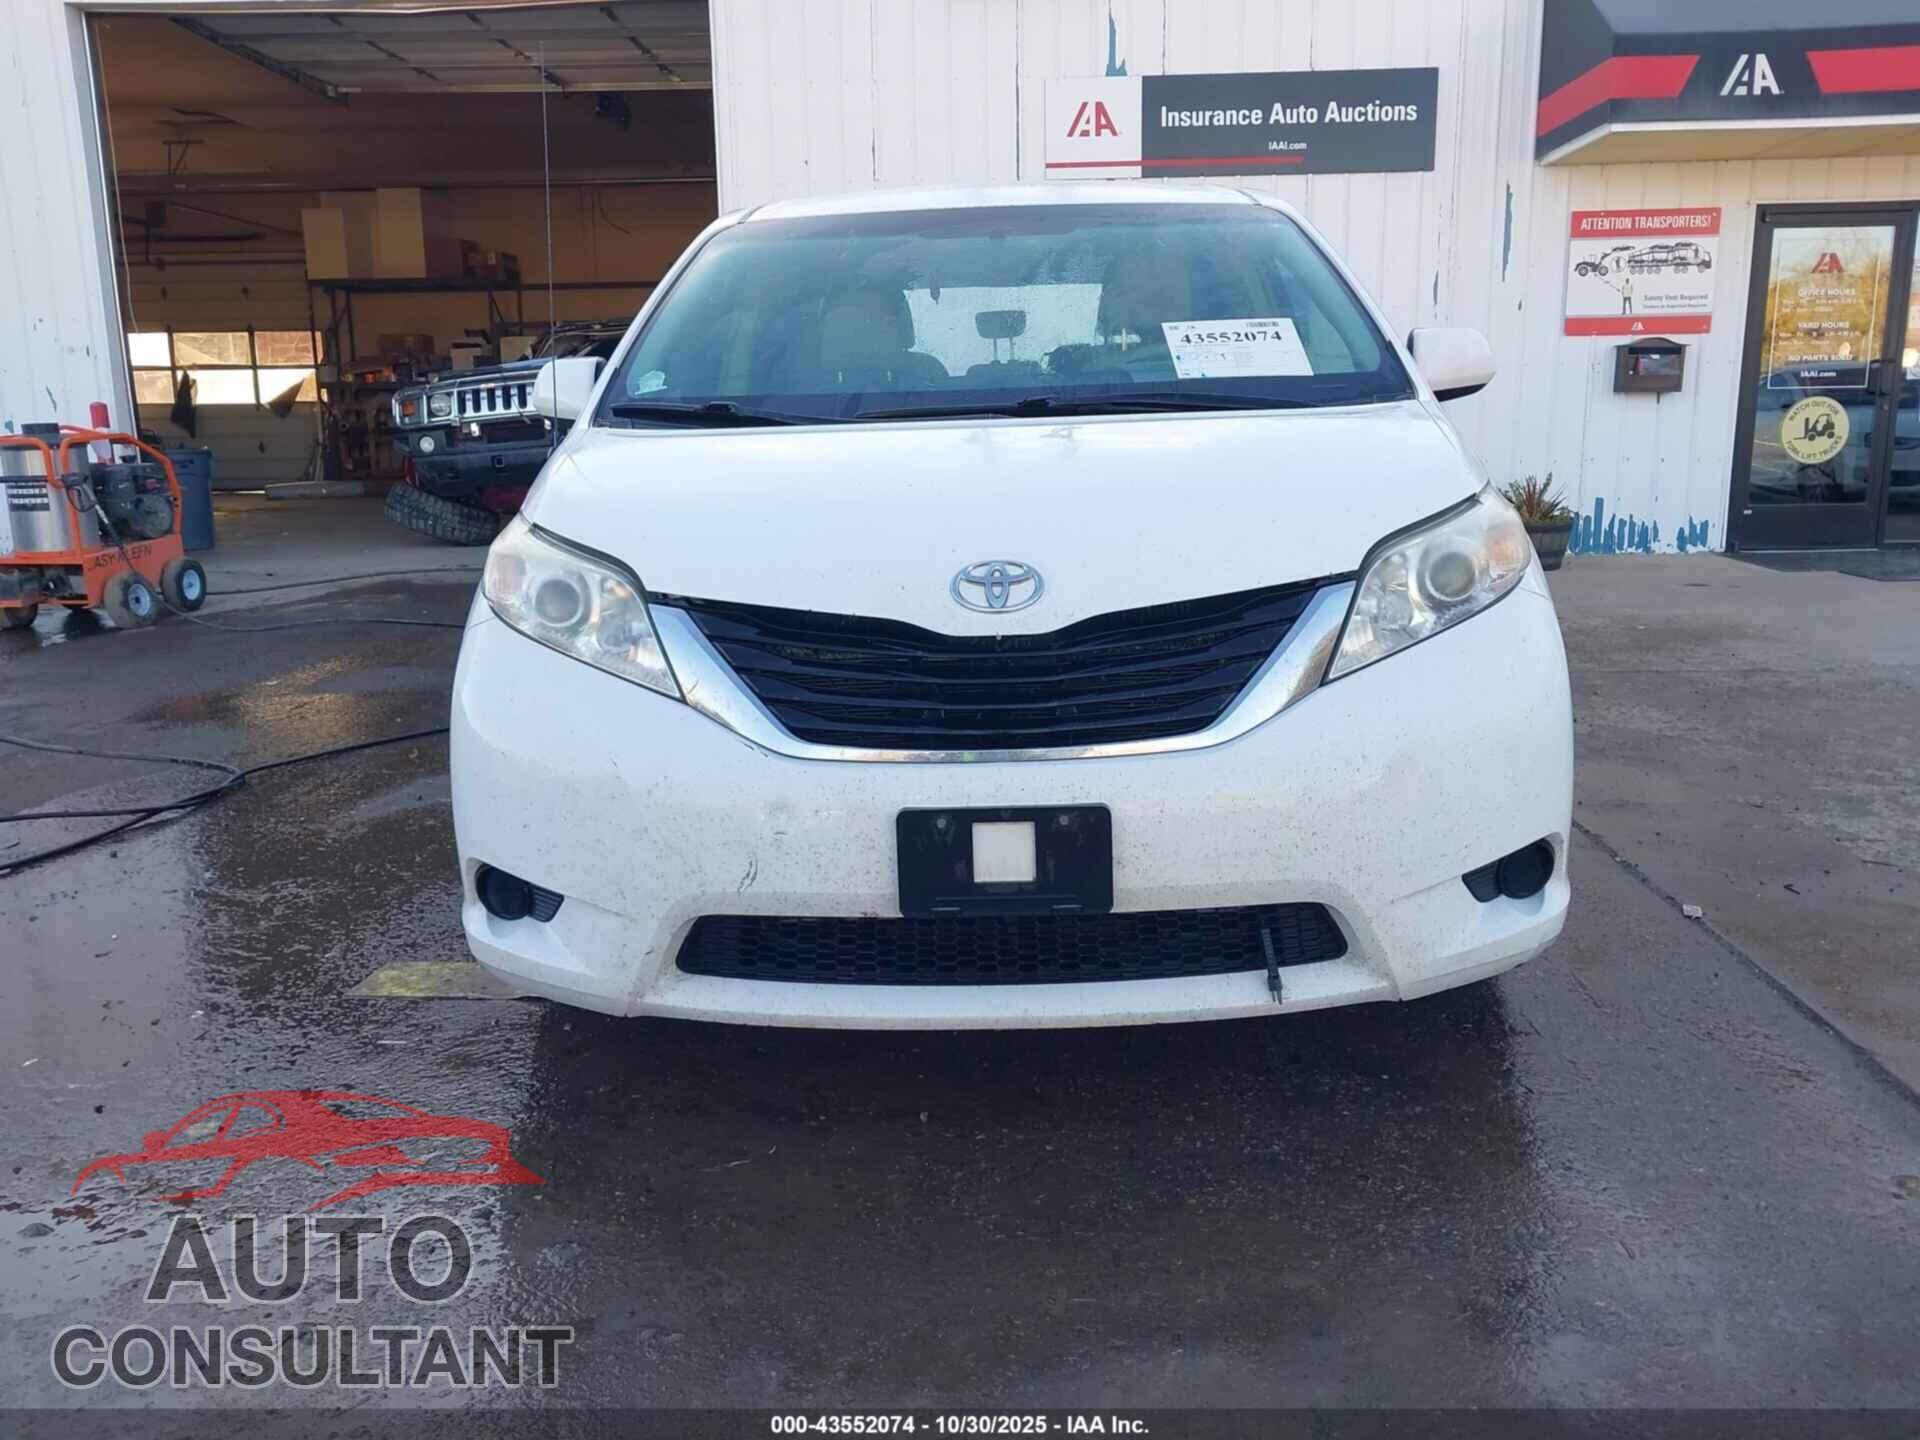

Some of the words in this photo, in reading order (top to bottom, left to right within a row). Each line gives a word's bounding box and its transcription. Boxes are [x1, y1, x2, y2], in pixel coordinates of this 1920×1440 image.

[1161, 105, 1262, 127] Insurance
[1269, 102, 1318, 125] Auto
[1325, 100, 1418, 123] Auctions
[1268, 140, 1307, 150] IAAI.com
[1580, 217, 1632, 230] ATTENTION
[1635, 214, 1712, 229] TRANSPORTERS!
[1827, 287, 1856, 296] HOURS
[1822, 320, 1850, 329] HOURS
[1180, 331, 1282, 344] 43552074
